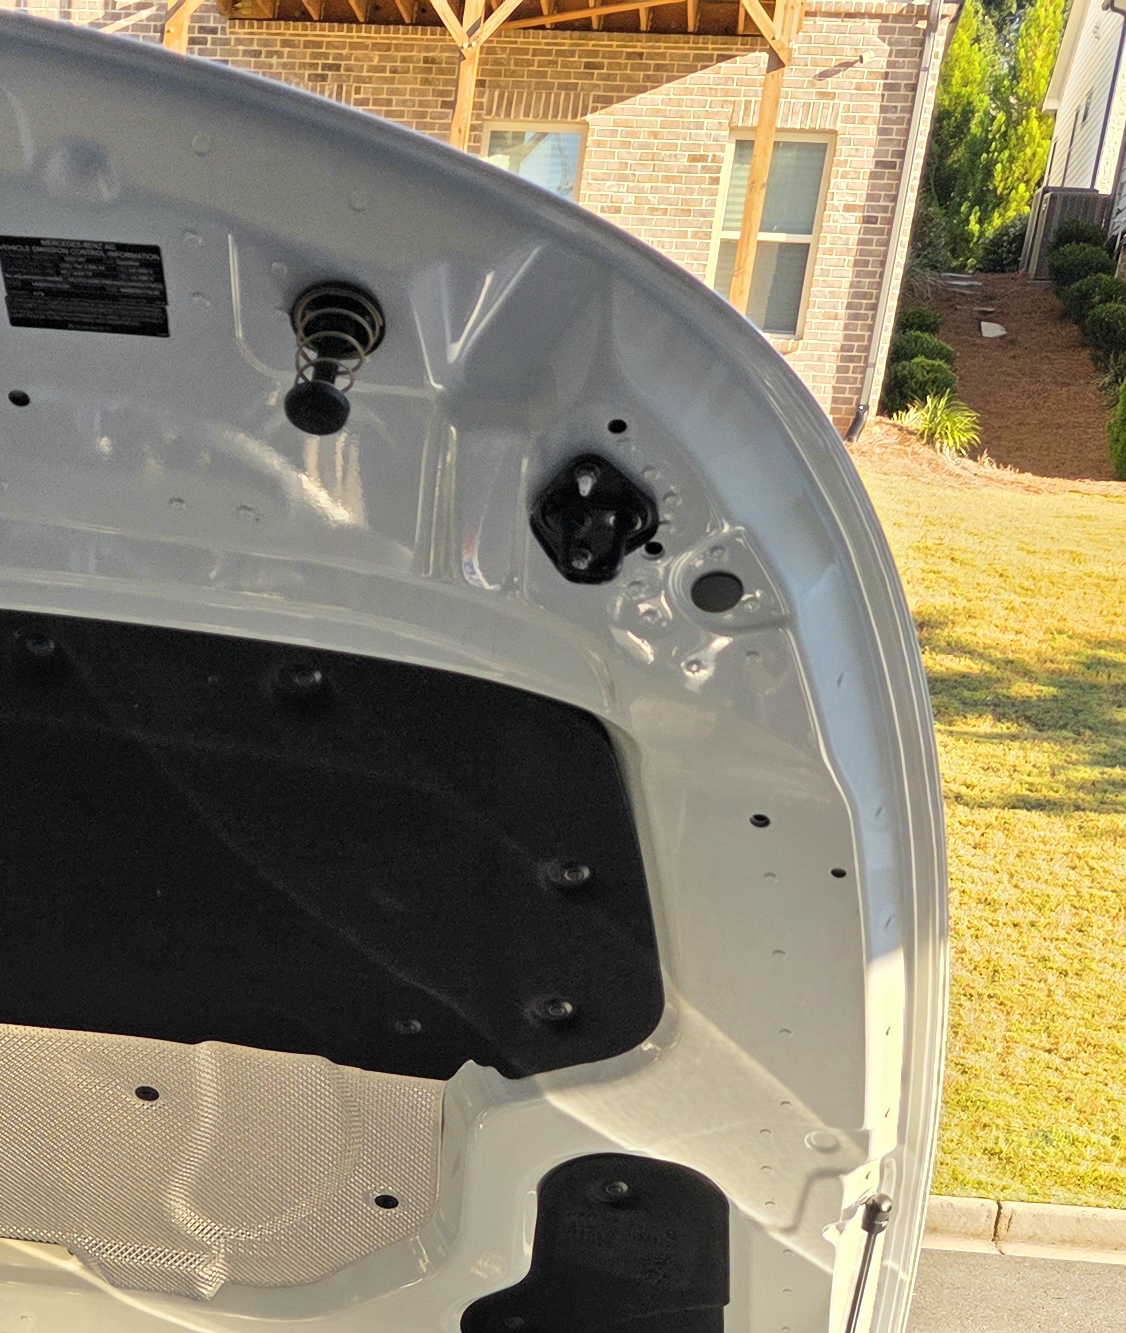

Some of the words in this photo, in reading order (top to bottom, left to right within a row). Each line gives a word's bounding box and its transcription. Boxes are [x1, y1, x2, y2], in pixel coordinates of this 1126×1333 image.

[32, 245, 69, 255] EMISSION
[70, 248, 105, 257] CONTROL
[107, 250, 160, 260] INFORMATION
